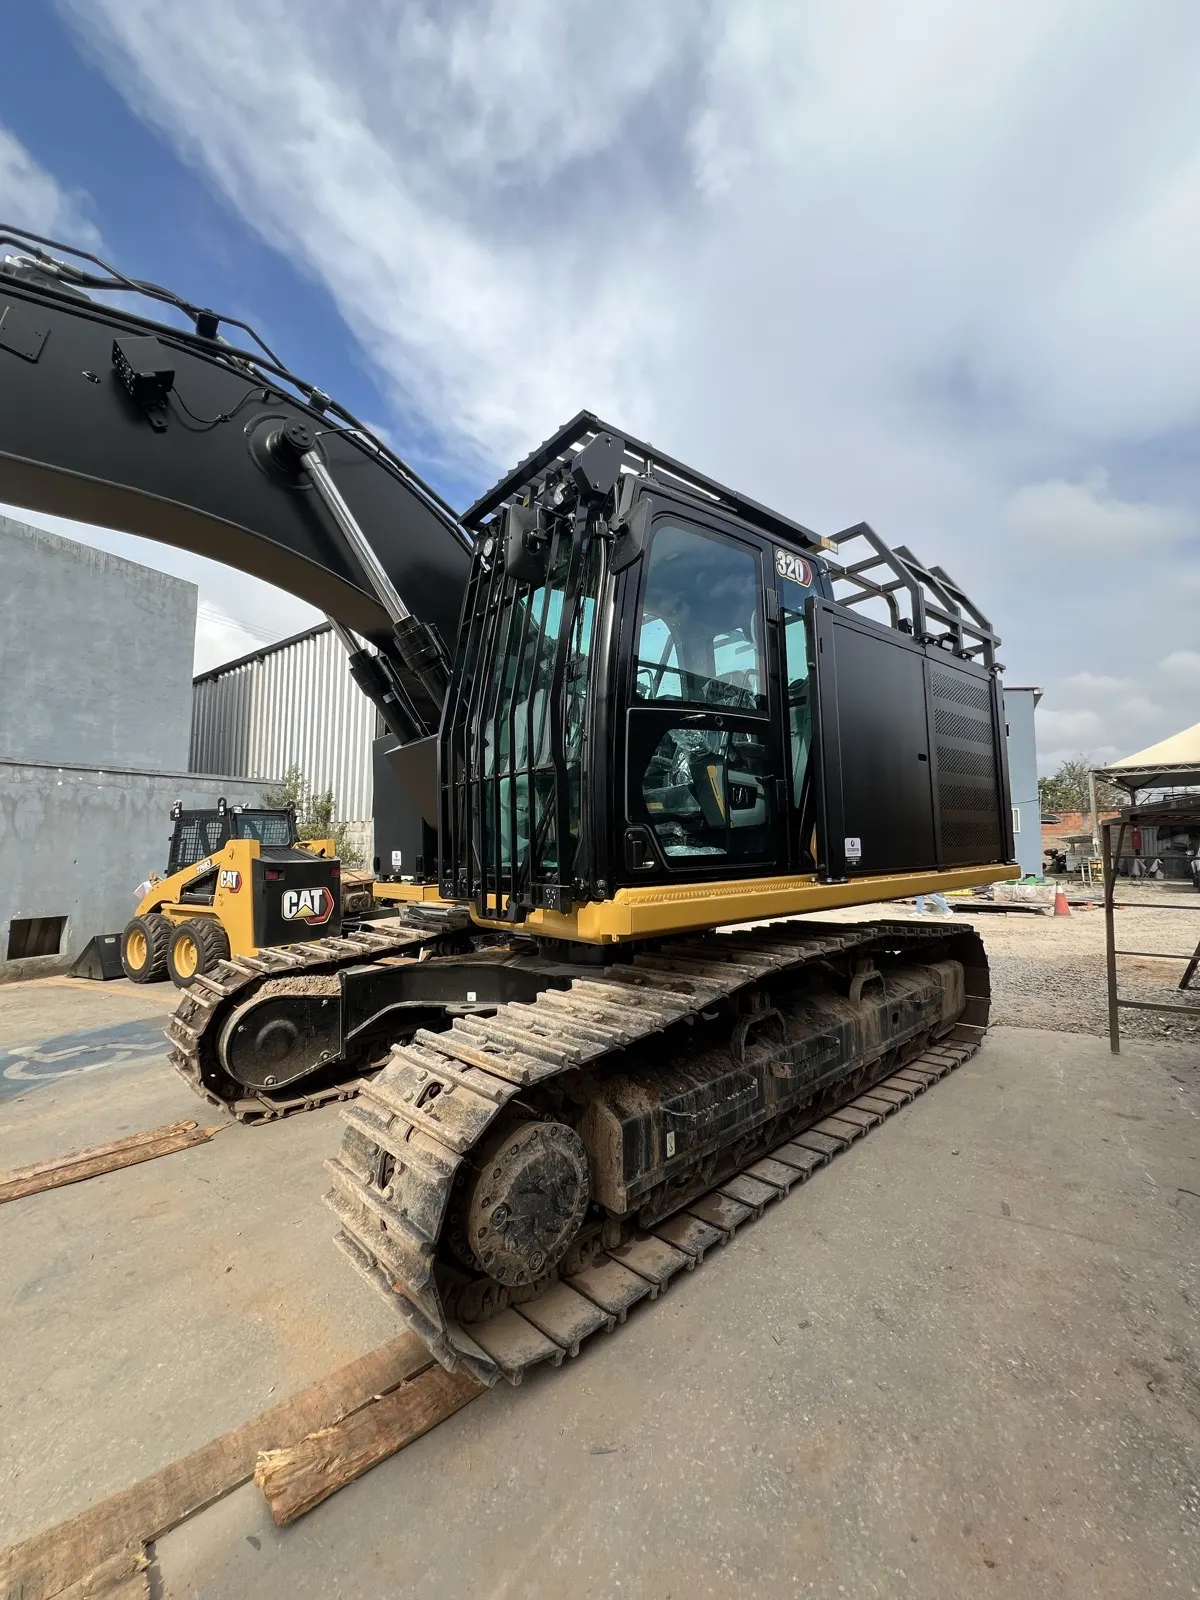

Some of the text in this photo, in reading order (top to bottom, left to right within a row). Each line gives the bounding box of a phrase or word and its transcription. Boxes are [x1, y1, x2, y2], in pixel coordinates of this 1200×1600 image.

[777, 550, 804, 582] 320
[221, 870, 238, 888] CAT
[283, 889, 323, 919] CAT
